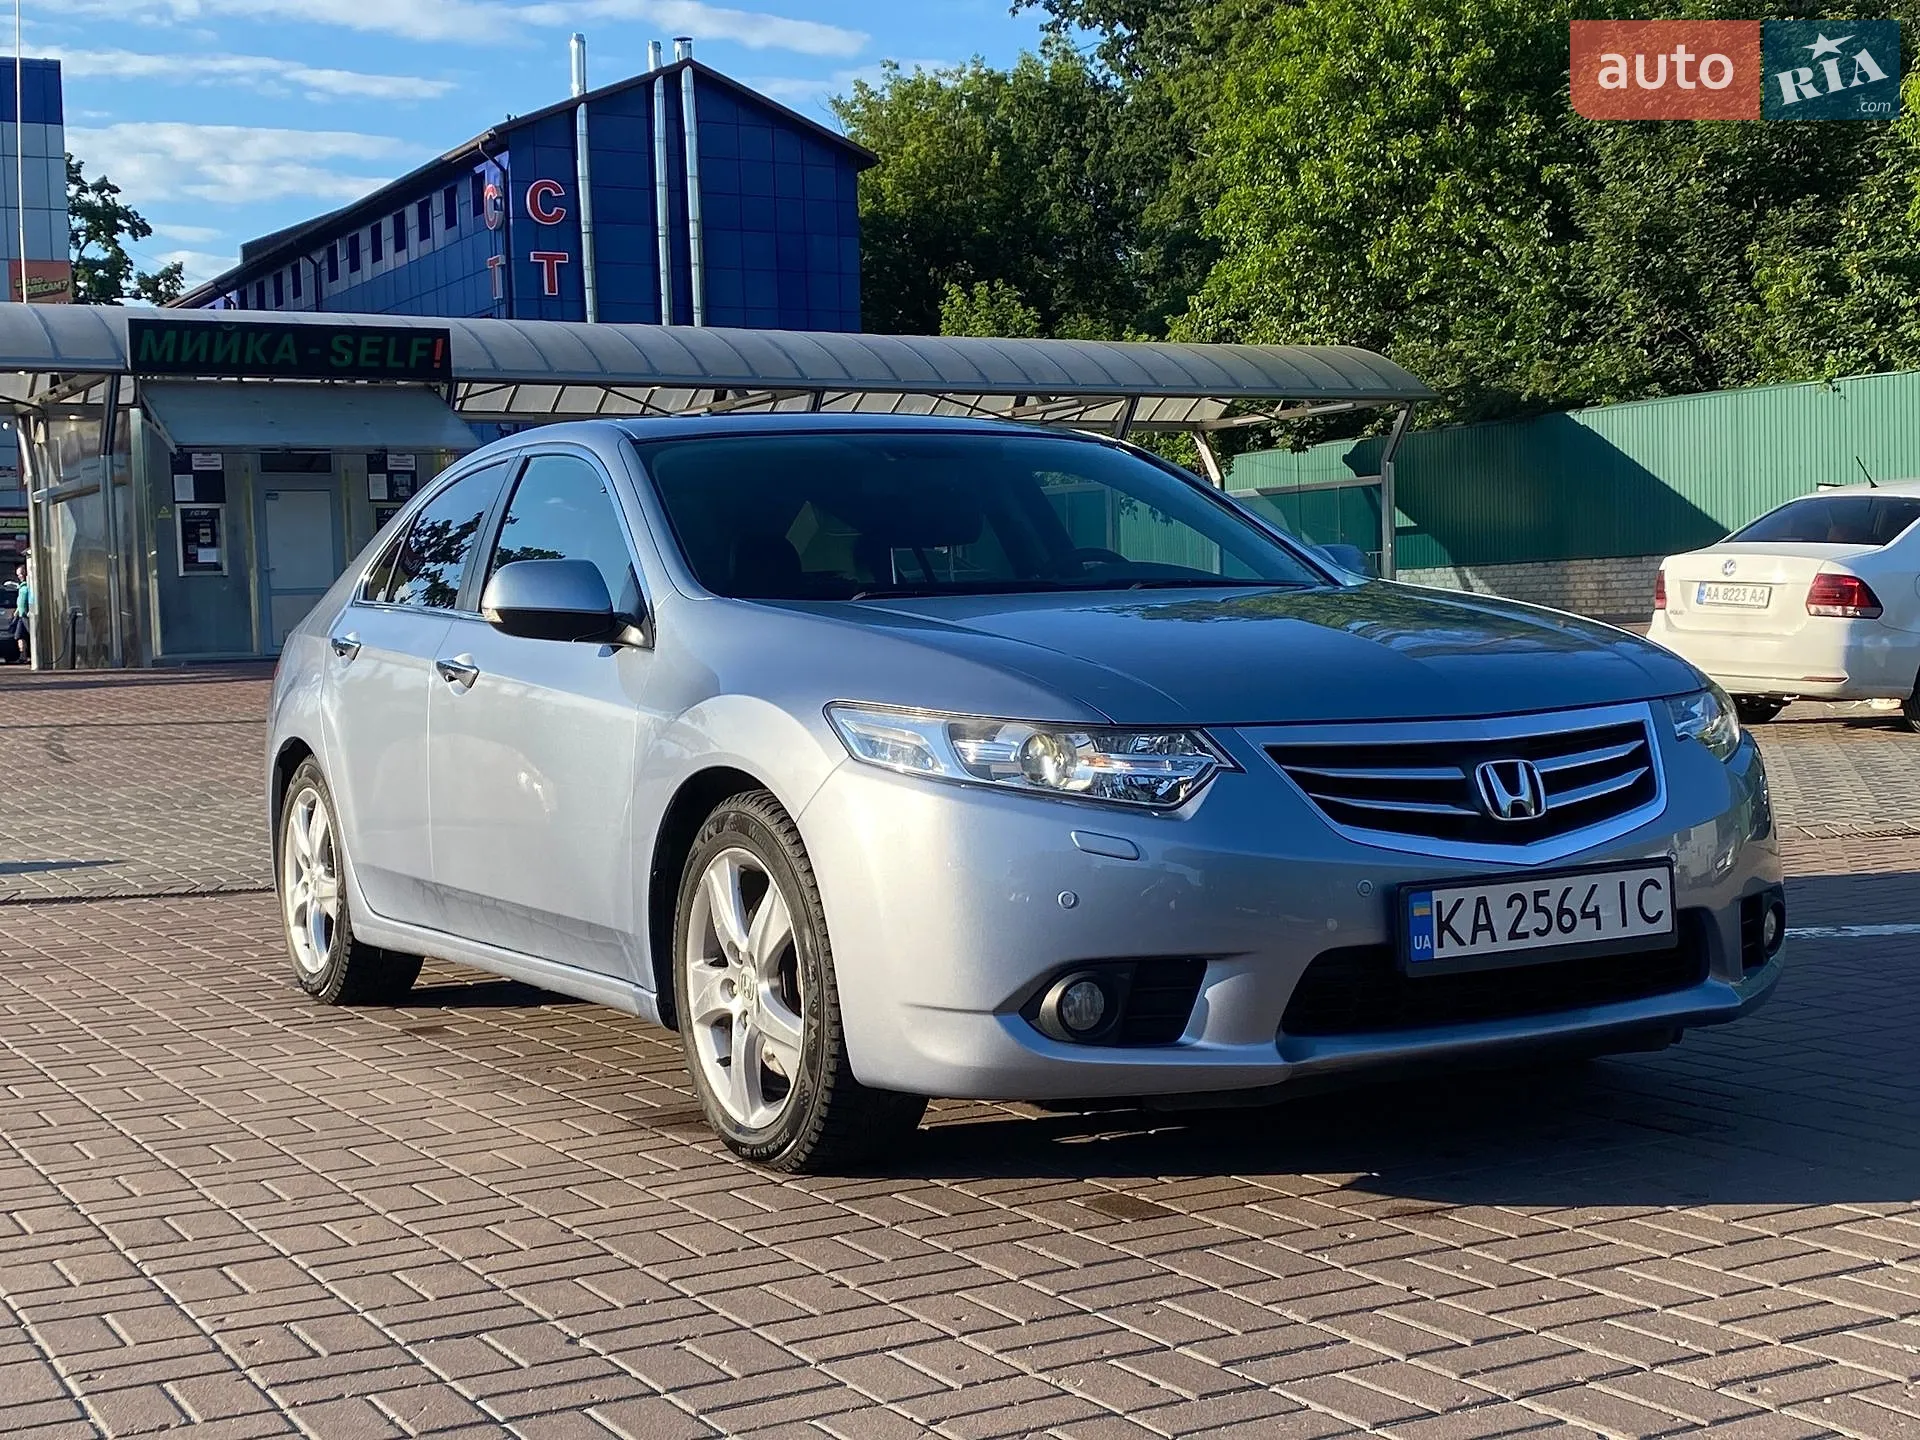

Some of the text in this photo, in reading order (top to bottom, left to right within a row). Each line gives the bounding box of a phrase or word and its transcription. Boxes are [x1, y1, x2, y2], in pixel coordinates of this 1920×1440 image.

[138, 324, 298, 366] МИЙКА
[328, 334, 444, 369] SELF!
[1705, 586, 1766, 603] AA 8223 AA
[1436, 878, 1664, 949] KA 2564 IC
[1414, 934, 1432, 950] UA
